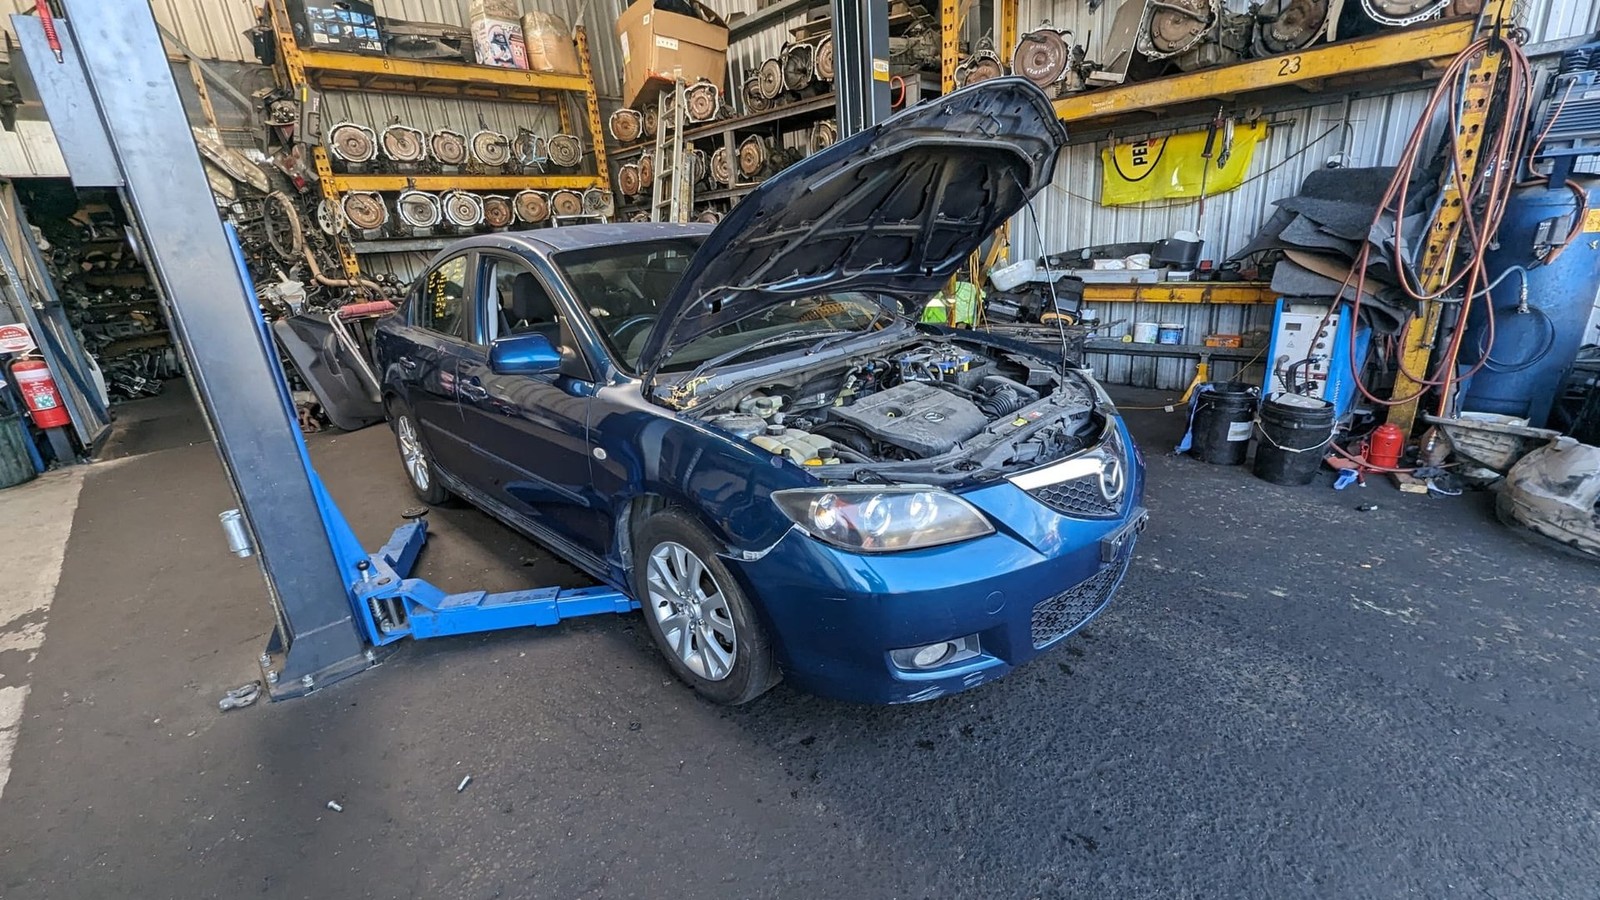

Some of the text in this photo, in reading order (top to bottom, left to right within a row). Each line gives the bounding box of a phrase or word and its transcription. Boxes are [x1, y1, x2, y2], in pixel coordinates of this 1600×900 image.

[383, 60, 389, 70] 8
[1278, 56, 1301, 77] 23
[526, 73, 532, 83] 9
